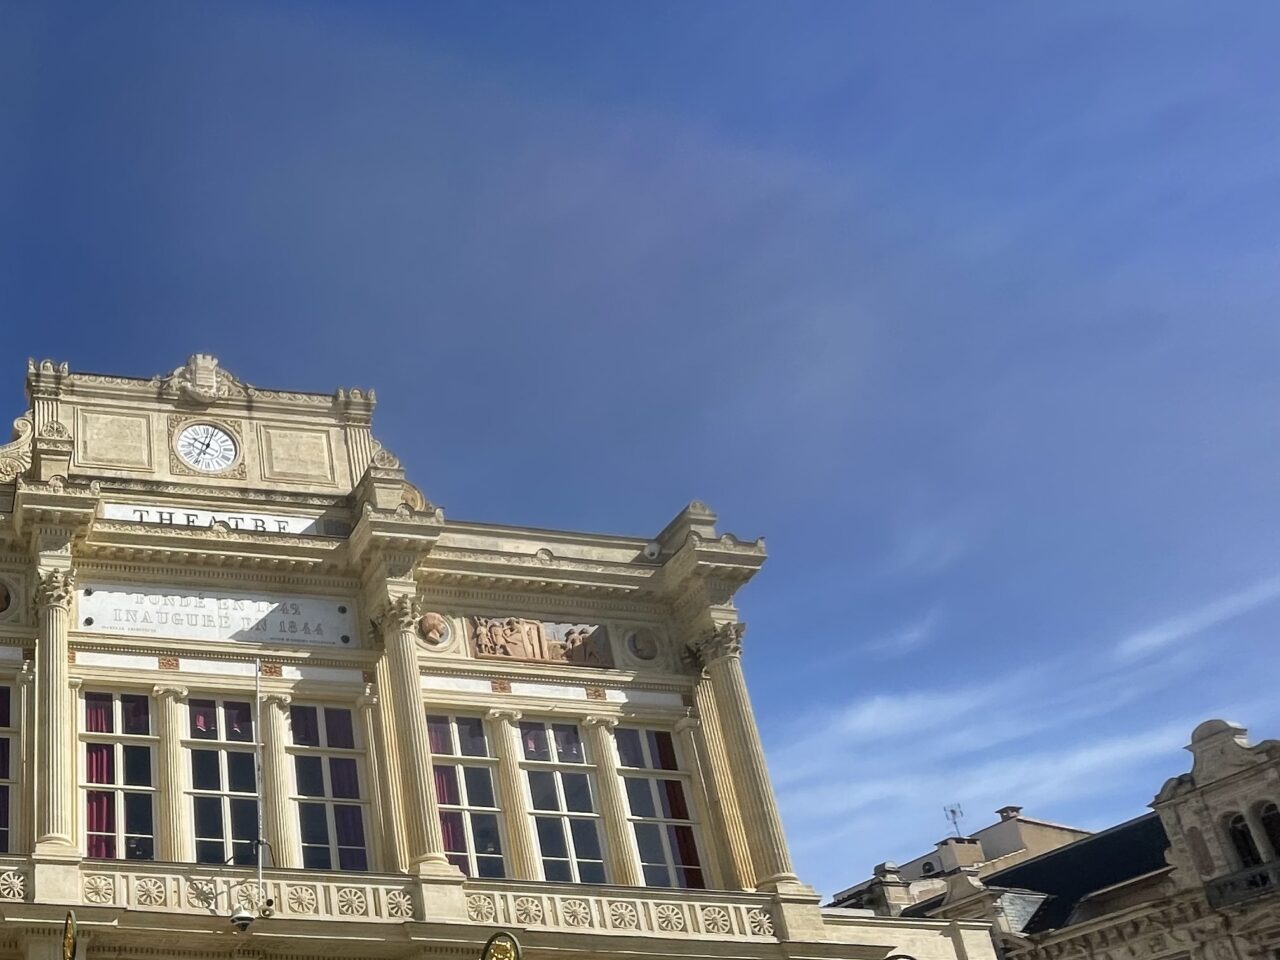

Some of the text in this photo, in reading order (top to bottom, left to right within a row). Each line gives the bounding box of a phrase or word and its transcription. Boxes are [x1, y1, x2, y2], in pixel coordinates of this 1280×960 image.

[113, 608, 231, 629] INAUGURÉ
[241, 616, 268, 632] EN
[279, 620, 324, 636] 1844
